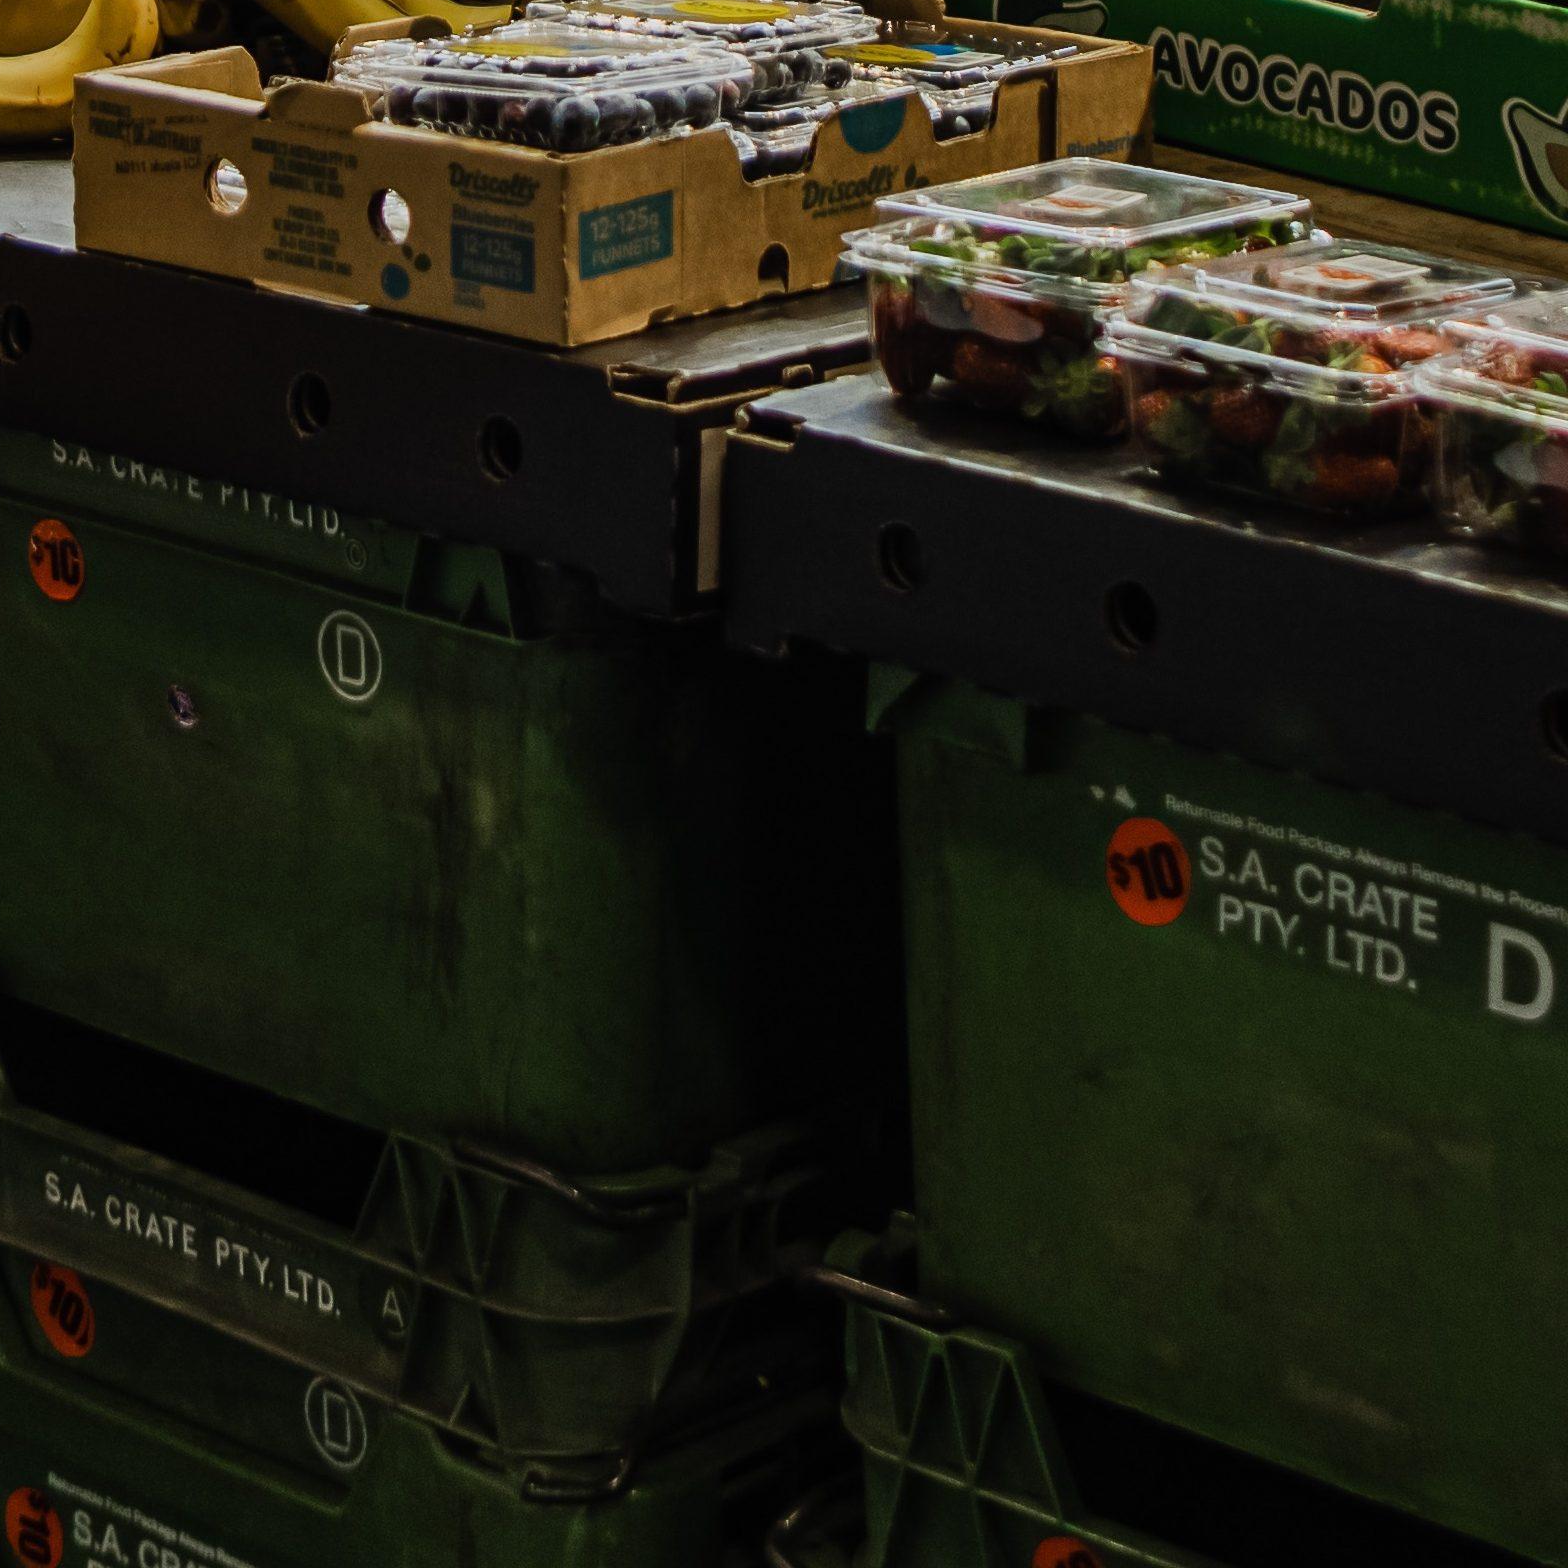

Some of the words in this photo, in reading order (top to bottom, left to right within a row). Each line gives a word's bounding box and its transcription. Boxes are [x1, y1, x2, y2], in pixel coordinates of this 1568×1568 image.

[1153, 26, 1458, 154] AVOCADOS
[449, 161, 541, 201] Driscoll's
[801, 163, 898, 211] Driscoll's
[1107, 840, 1186, 902] $10
[1163, 792, 1246, 830] Returnable
[1247, 817, 1285, 842] Food
[1287, 826, 1352, 861] Package
[1354, 845, 1408, 877] Always
[1411, 863, 1478, 898] Remains
[1198, 834, 1279, 896] S.A.
[1292, 861, 1440, 942] CRATE
[1218, 893, 1307, 958] PTY.
[1326, 924, 1419, 992] LTD.
[1487, 920, 1556, 1022] D
[44, 1170, 97, 1220] S.A.
[104, 1194, 199, 1260] CRATE
[214, 1236, 275, 1291] PTY.
[282, 1263, 343, 1320] LTD.
[72, 1508, 130, 1564] S.A.
